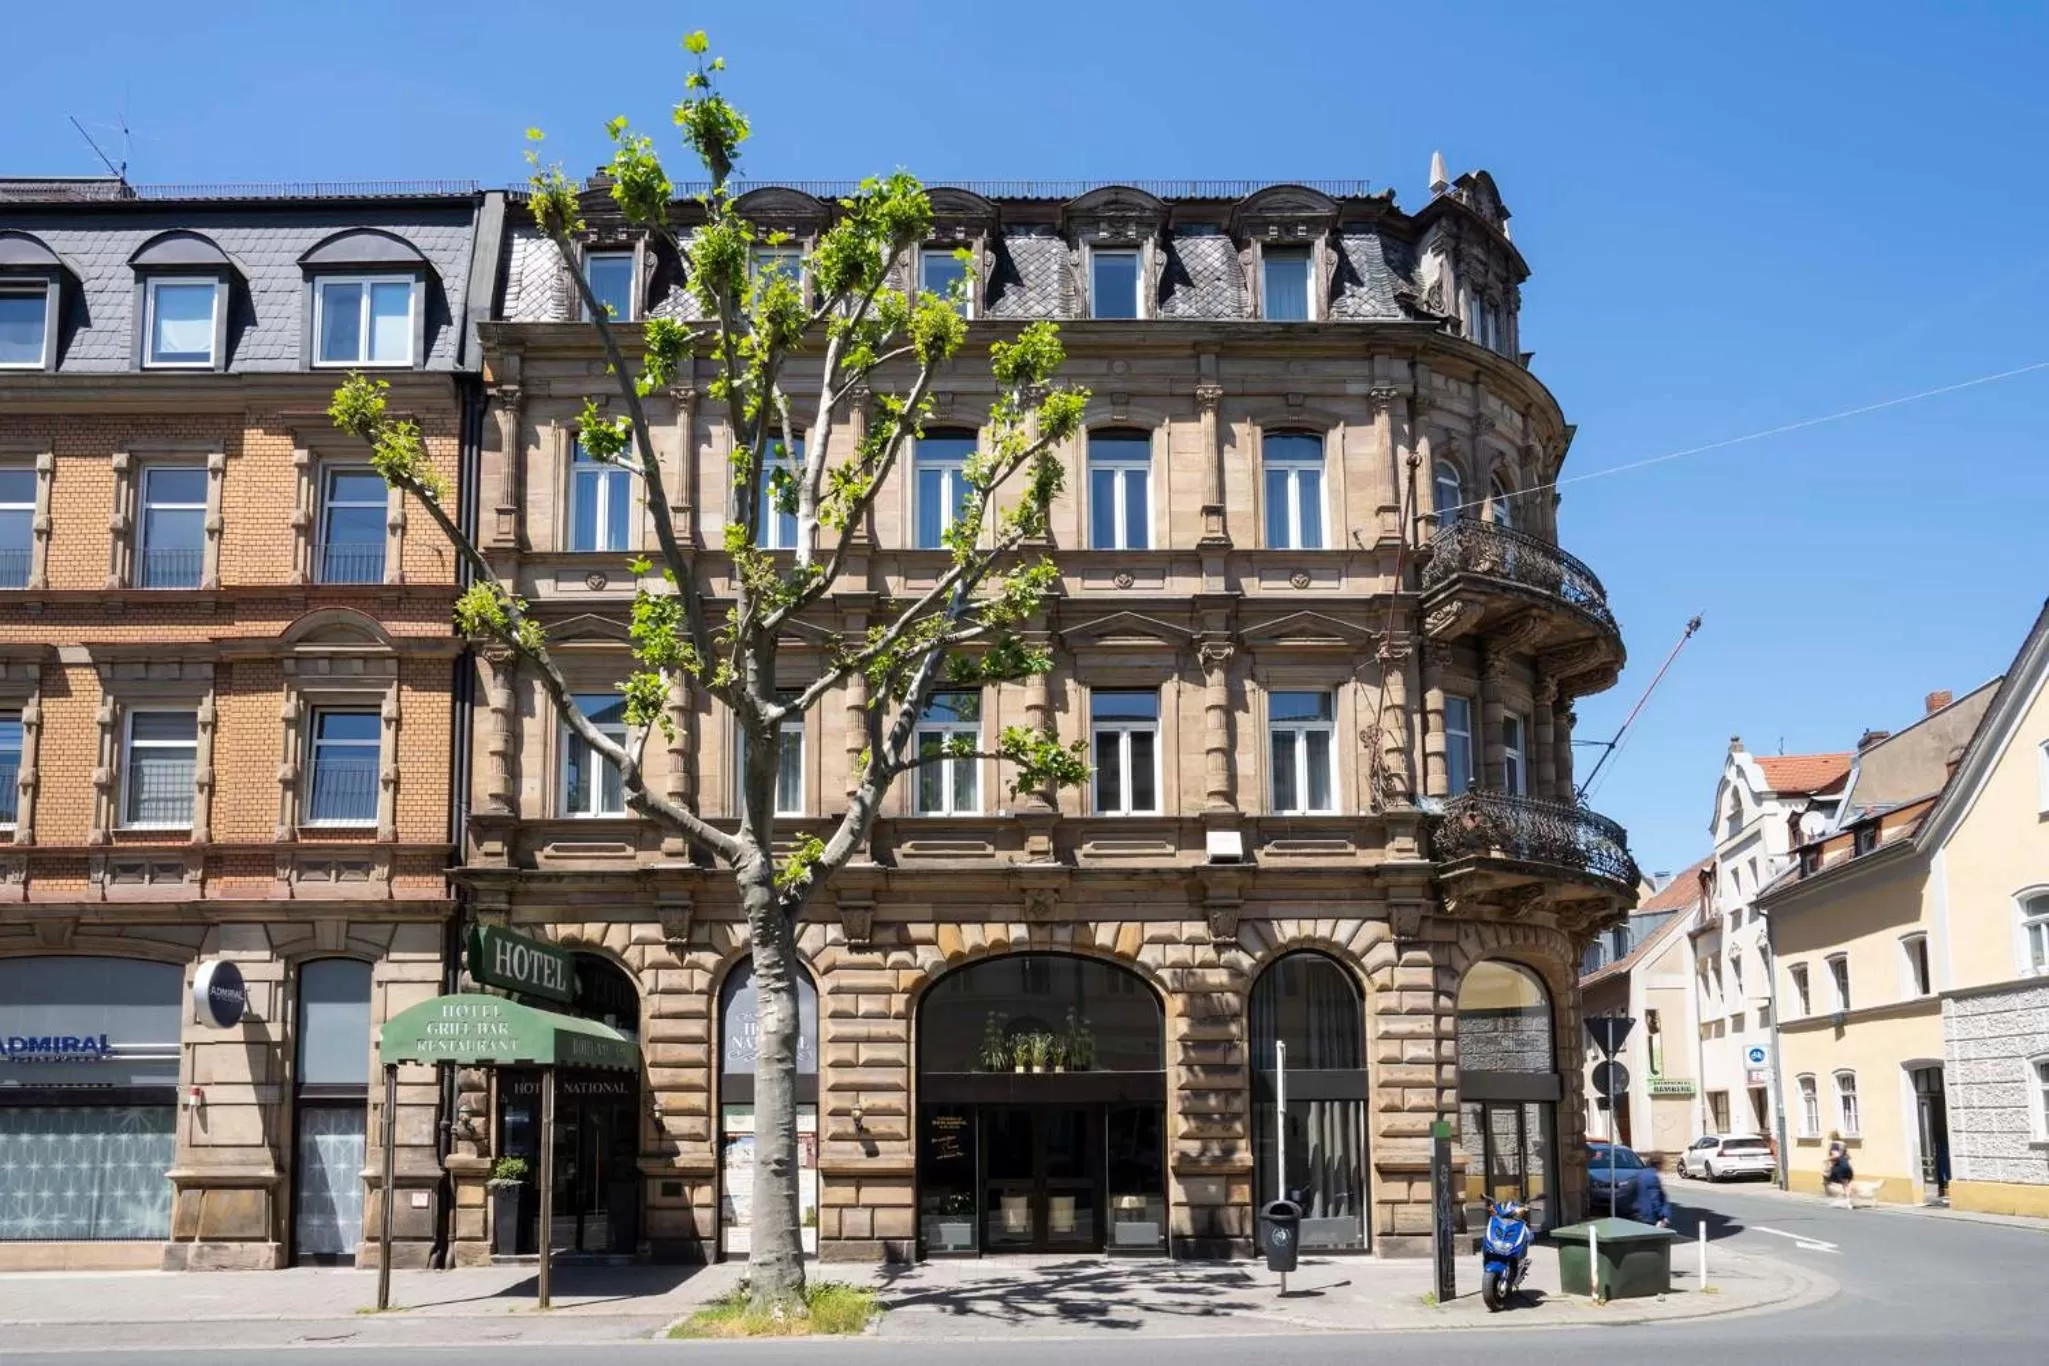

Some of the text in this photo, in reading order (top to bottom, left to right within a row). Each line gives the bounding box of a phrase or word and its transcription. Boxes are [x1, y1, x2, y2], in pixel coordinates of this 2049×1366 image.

[494, 937, 568, 992] HOTEL
[443, 1005, 502, 1017] HOTEL
[416, 1040, 518, 1051] RESTAURANT
[563, 1082, 629, 1095] NATIONAL
